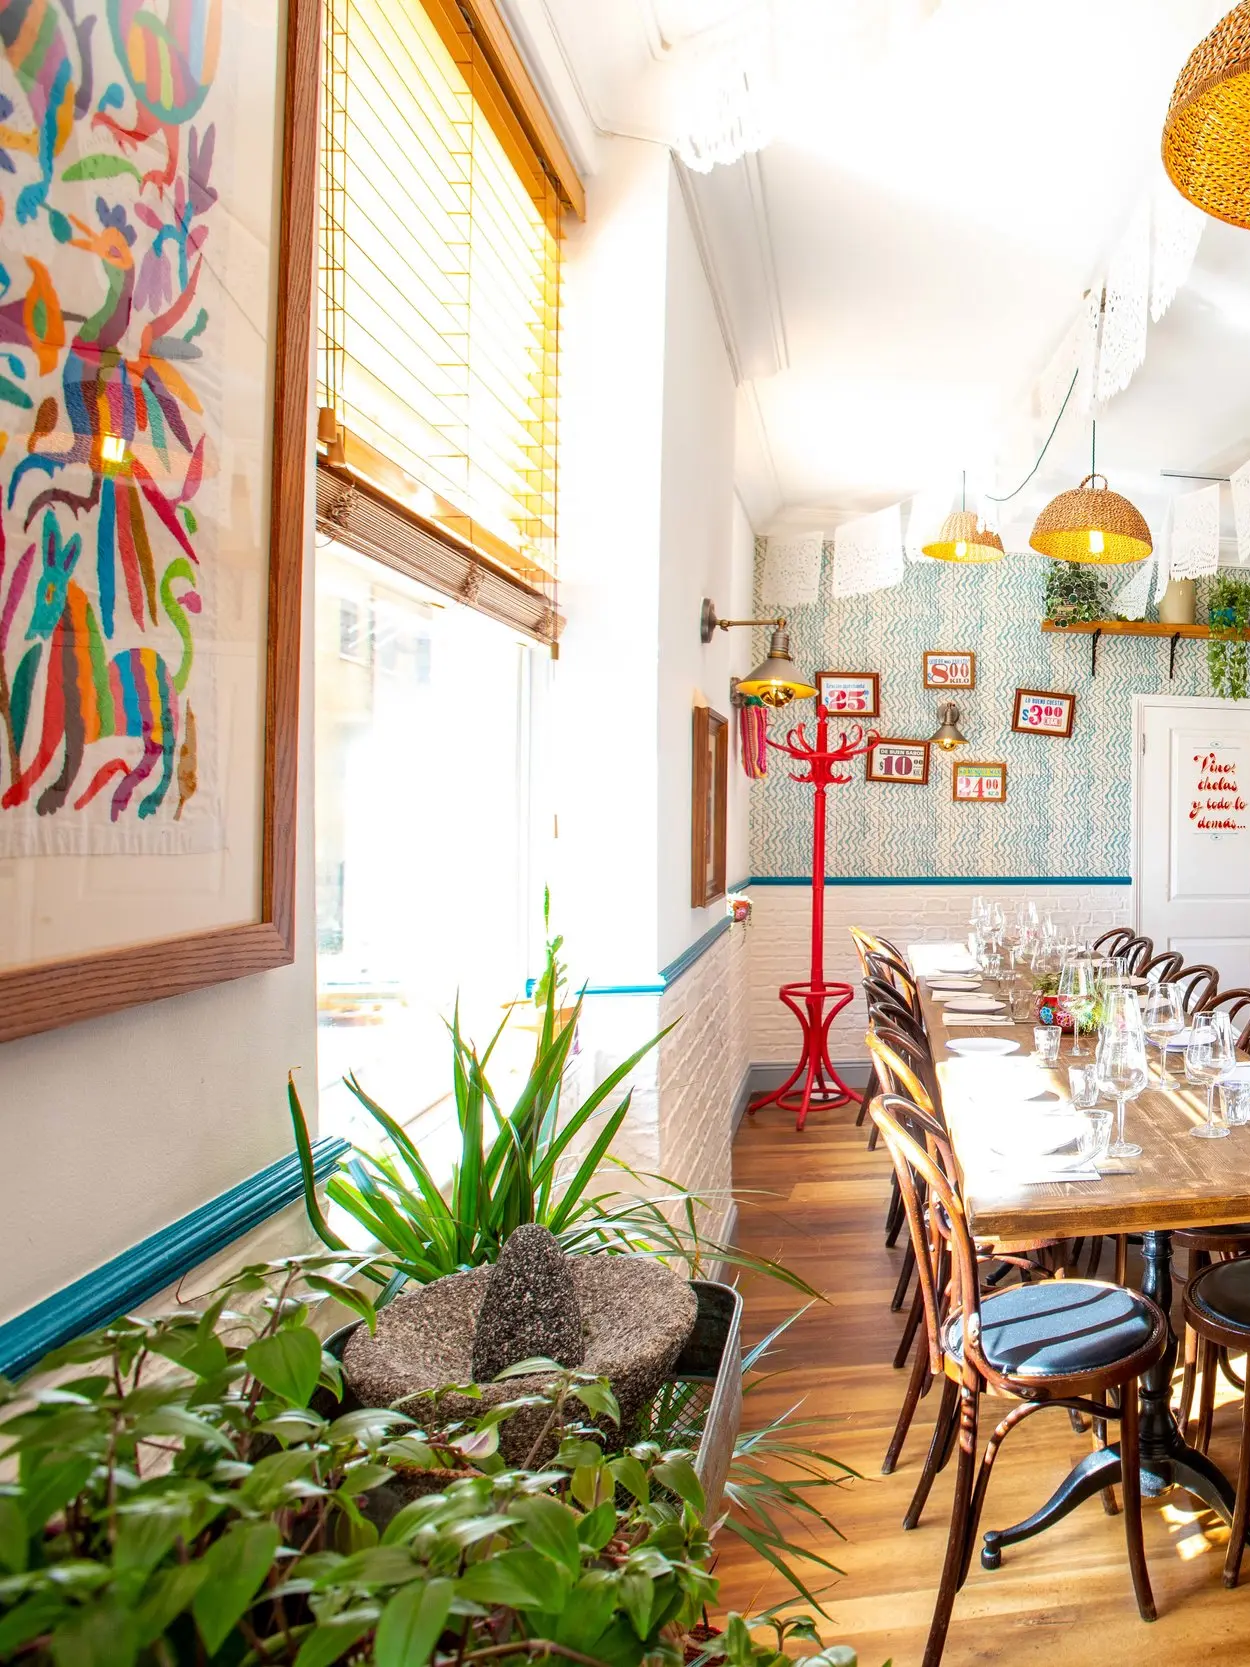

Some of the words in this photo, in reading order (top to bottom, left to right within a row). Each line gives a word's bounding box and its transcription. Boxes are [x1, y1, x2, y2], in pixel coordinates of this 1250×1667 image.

[1197, 776, 1238, 792] chelas
[1188, 801, 1203, 819] y
[1206, 797, 1233, 809] todo
[1234, 796, 1248, 810] lo
